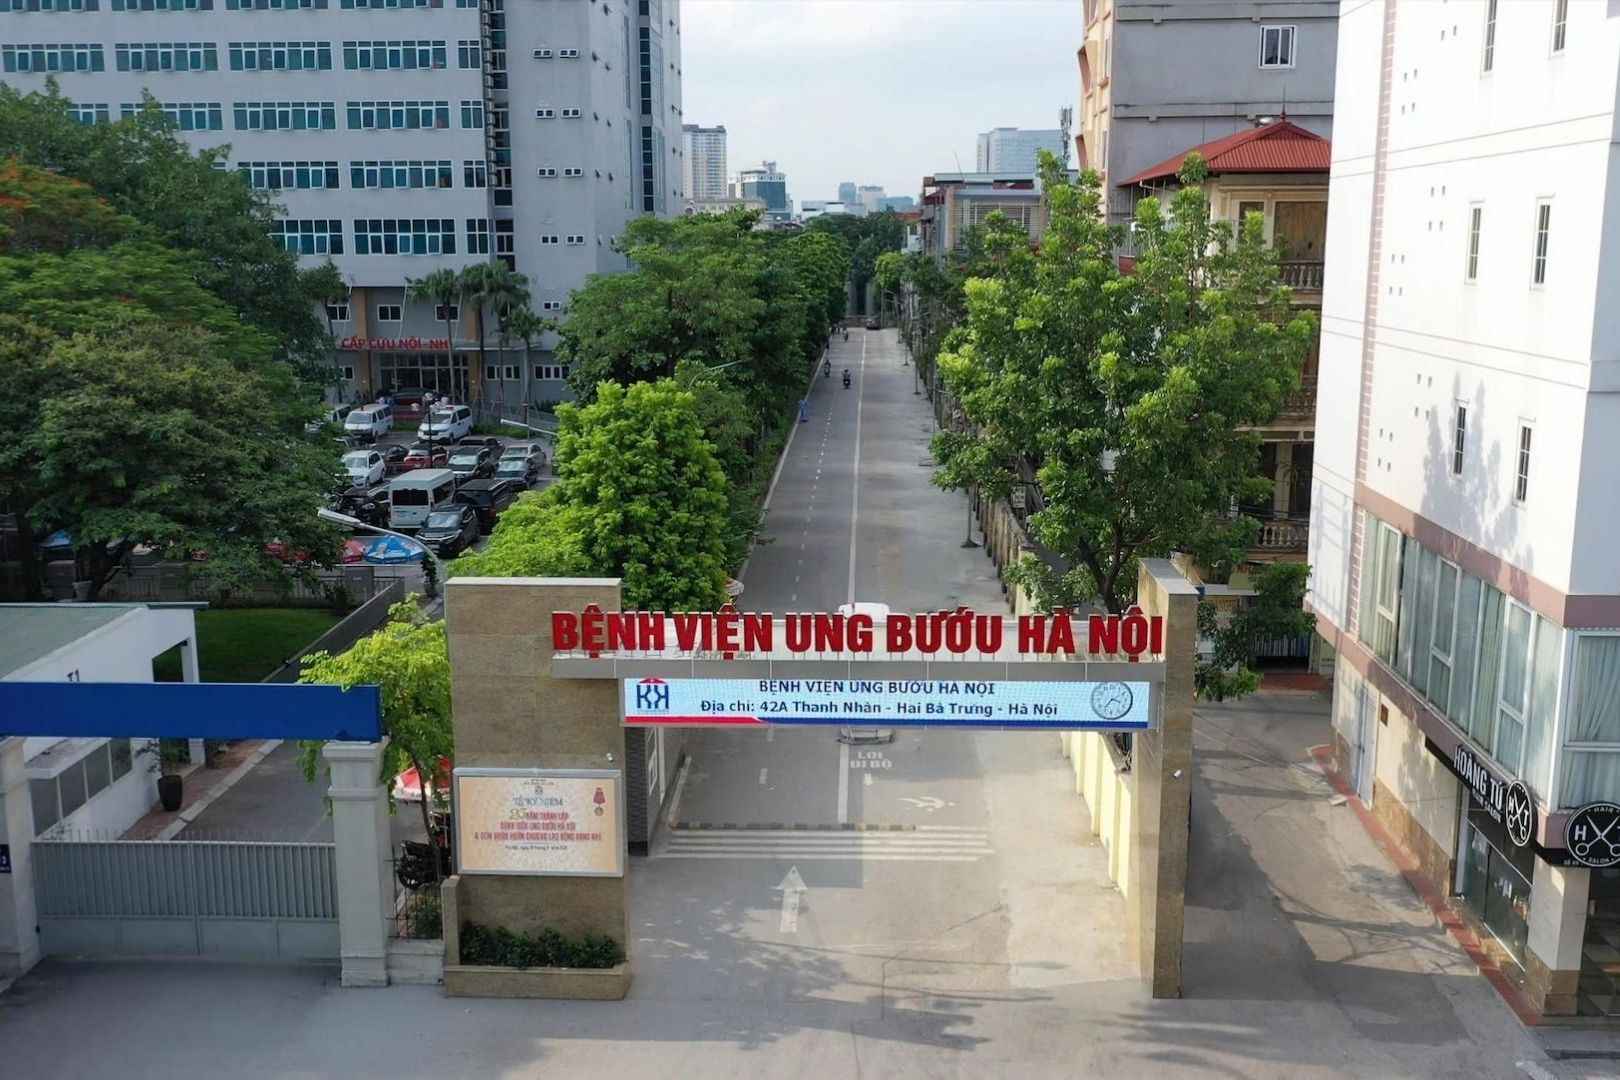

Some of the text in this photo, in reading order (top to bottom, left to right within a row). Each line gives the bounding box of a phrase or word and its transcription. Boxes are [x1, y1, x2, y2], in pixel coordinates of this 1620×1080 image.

[430, 337, 449, 350] NH
[552, 603, 1163, 662] BỆNH VIỆN UNG BƯỚU HÀ NỘI
[849, 681, 883, 693] UNG
[701, 701, 724, 715] Địa
[760, 701, 788, 712] 42A
[793, 701, 838, 713] Thanh
[897, 703, 921, 714] Hai
[950, 703, 993, 717] Trưng
[1453, 745, 1488, 795] HOÀNG
